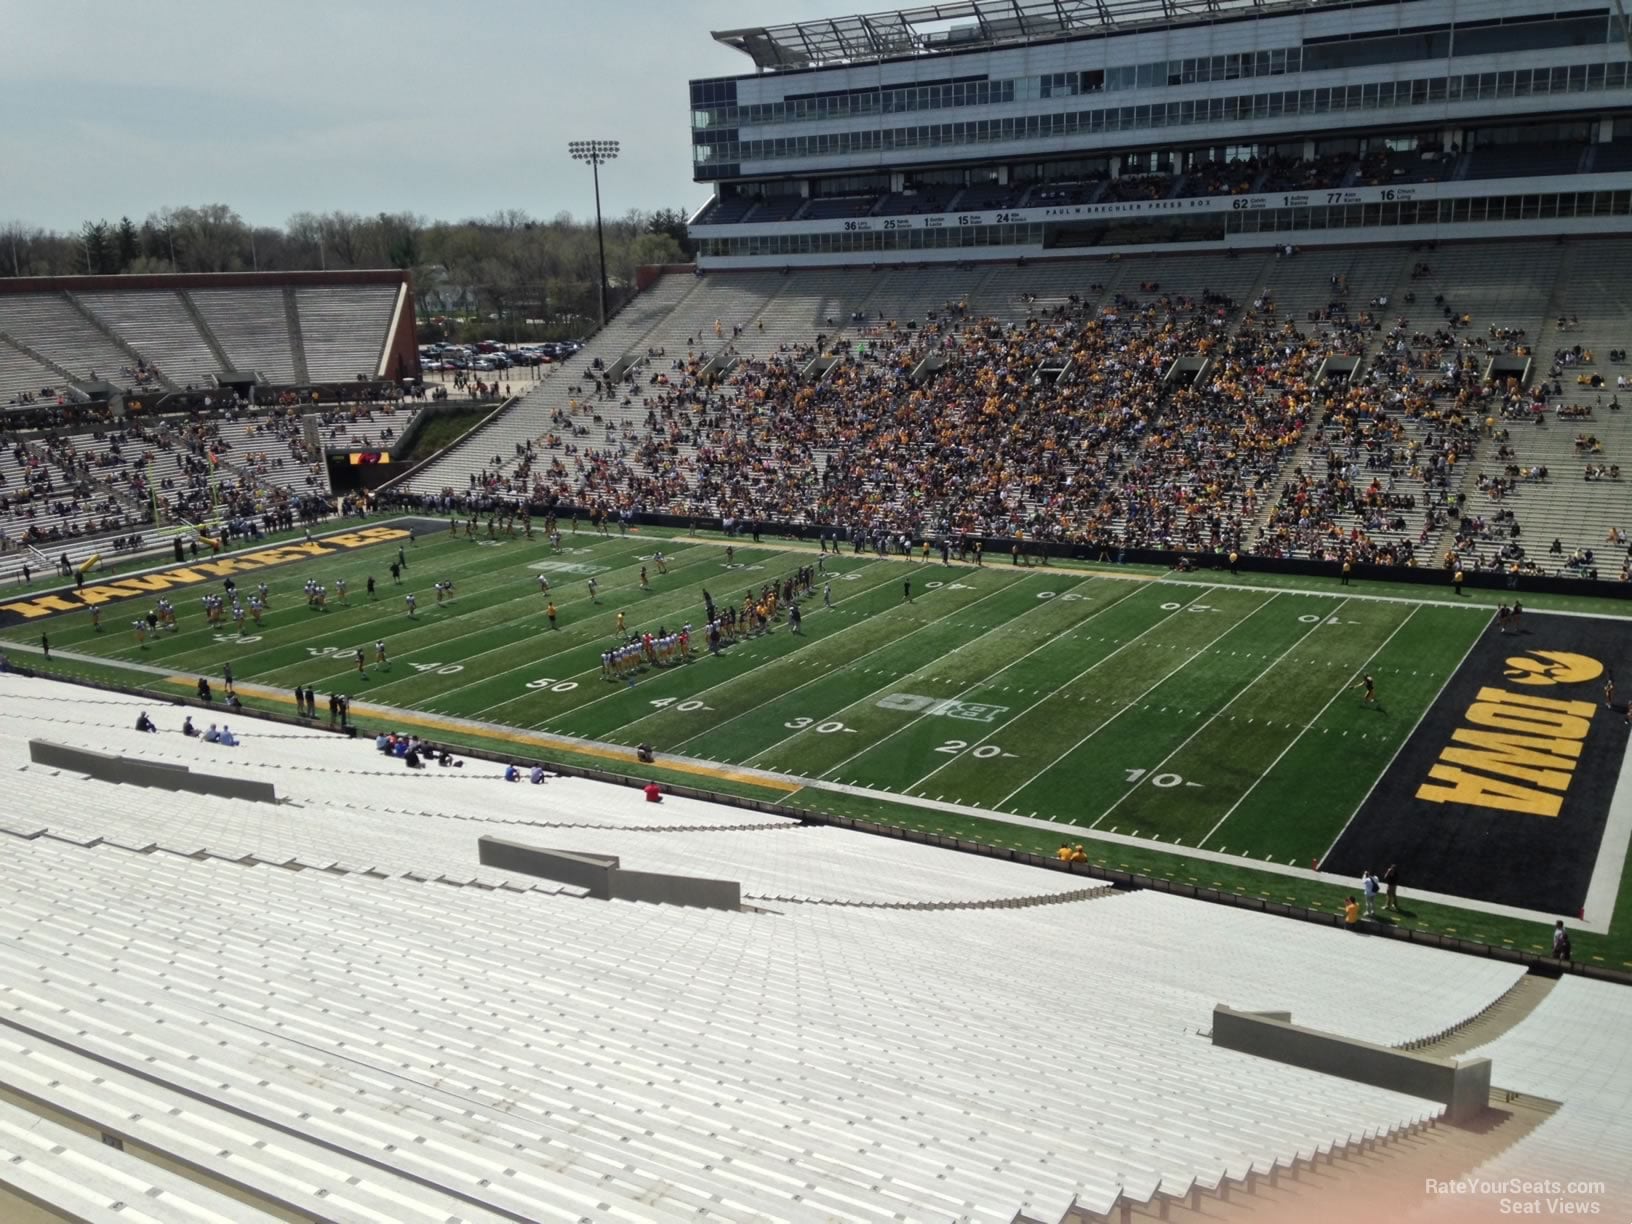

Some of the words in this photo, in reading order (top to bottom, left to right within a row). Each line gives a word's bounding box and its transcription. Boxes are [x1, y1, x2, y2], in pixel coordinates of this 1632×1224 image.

[1327, 193, 1342, 203] 77
[1381, 189, 1394, 200] 16
[1232, 199, 1248, 209] 62
[1283, 196, 1288, 206] 1
[1046, 207, 1070, 216] PAUL
[1148, 201, 1182, 209] PRESS
[1190, 199, 1211, 207] BOX
[883, 219, 896, 229] 25
[924, 218, 929, 227] 1
[958, 215, 968, 225] 15
[996, 213, 1009, 223] 24
[844, 221, 857, 231] 36
[2, 527, 411, 618] HAWKEYES
[415, 662, 465, 675] 40
[525, 678, 579, 692] 50
[649, 697, 705, 711] 40
[784, 717, 844, 734] 30
[934, 740, 1001, 758] 20
[1415, 687, 1597, 817] IOWA
[1125, 768, 1183, 788] 10
